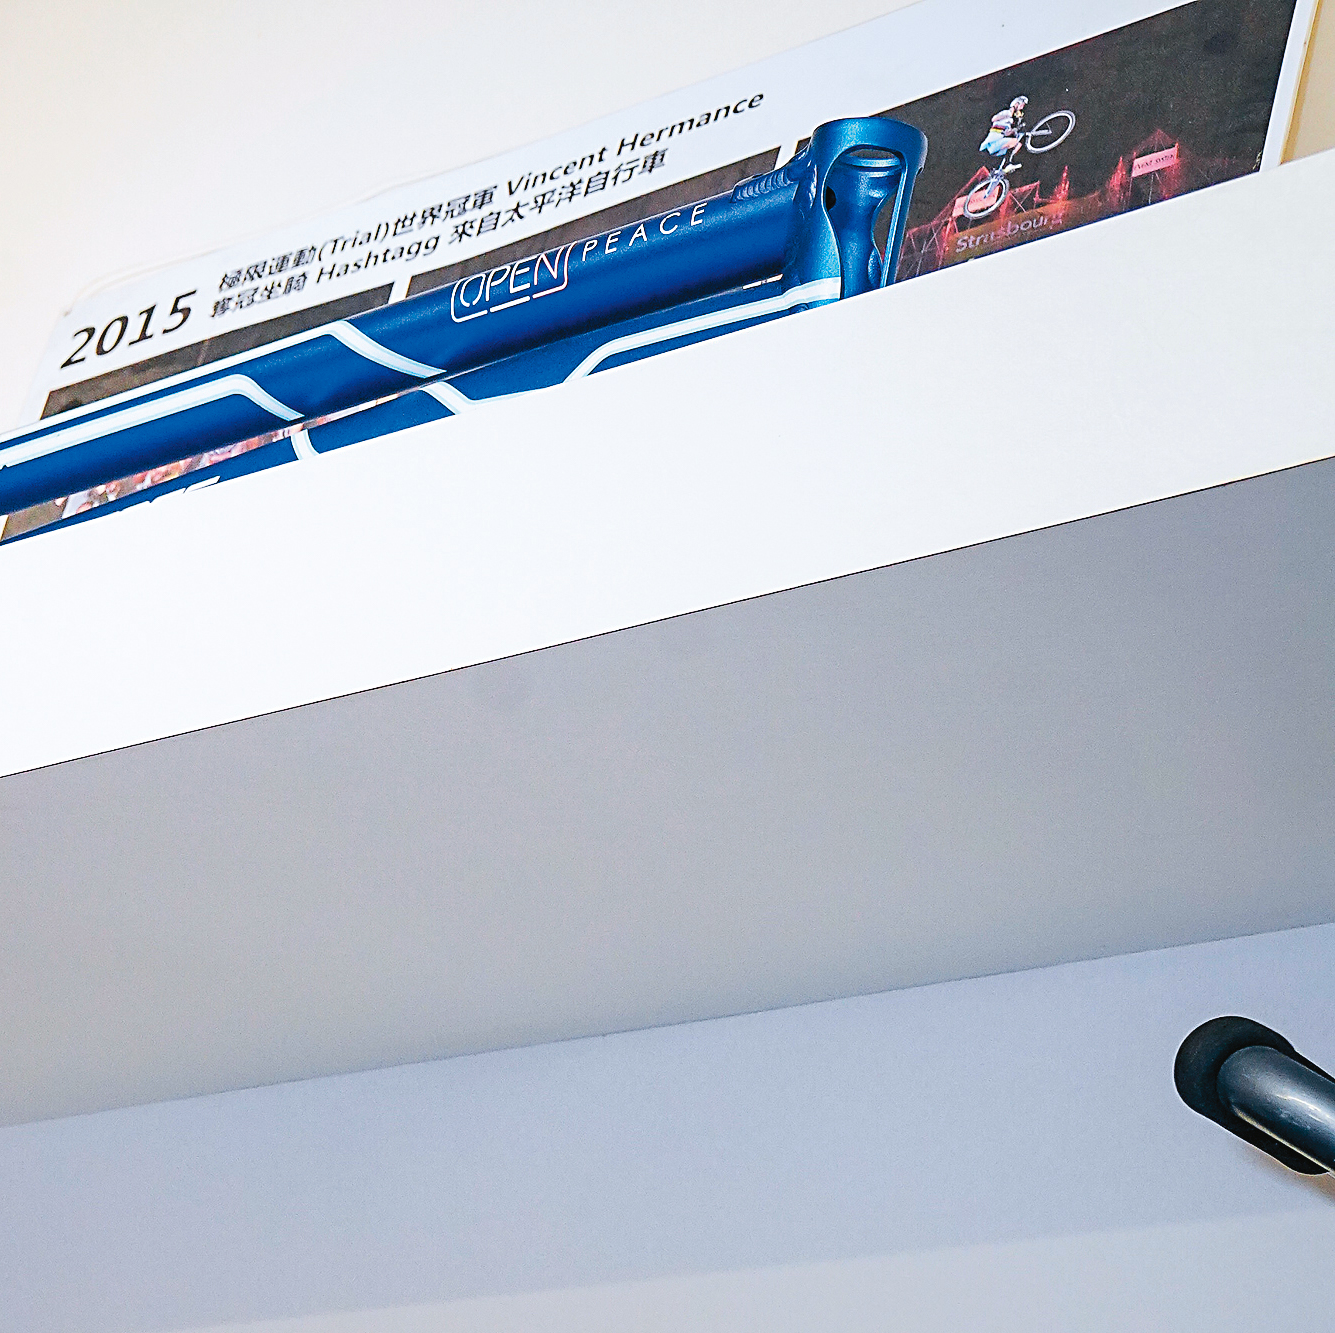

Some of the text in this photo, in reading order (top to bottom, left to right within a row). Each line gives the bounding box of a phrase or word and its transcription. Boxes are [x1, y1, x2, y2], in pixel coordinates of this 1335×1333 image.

[507, 147, 609, 197] Vincent
[616, 91, 765, 157] Hermance
[316, 234, 441, 284] Hashtagg
[447, 146, 670, 245] 來自太平洋自行車
[458, 201, 709, 309] OPEN PEACE
[60, 289, 197, 369] 2015
